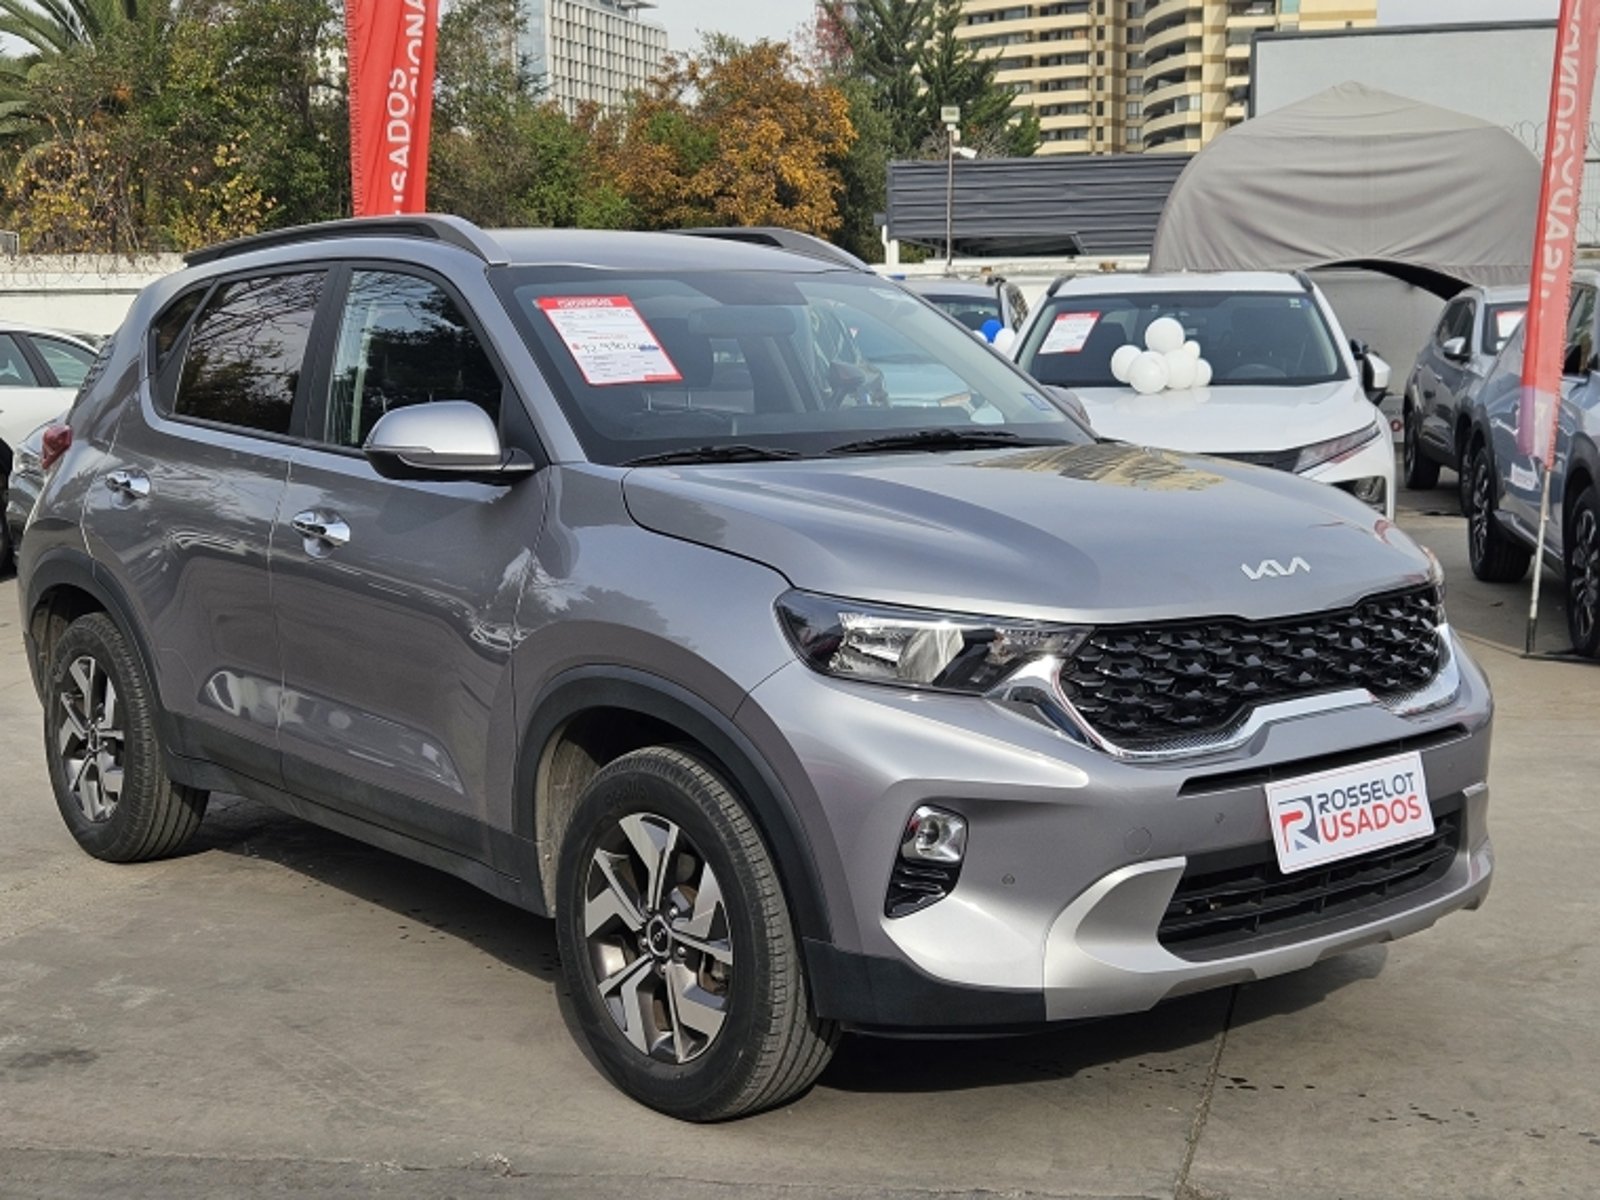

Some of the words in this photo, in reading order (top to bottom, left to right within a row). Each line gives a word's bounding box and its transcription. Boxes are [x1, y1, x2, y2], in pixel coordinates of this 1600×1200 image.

[1241, 556, 1311, 580] KIA
[1317, 772, 1414, 815] ROSSELOT
[1320, 795, 1422, 843] USADOS
